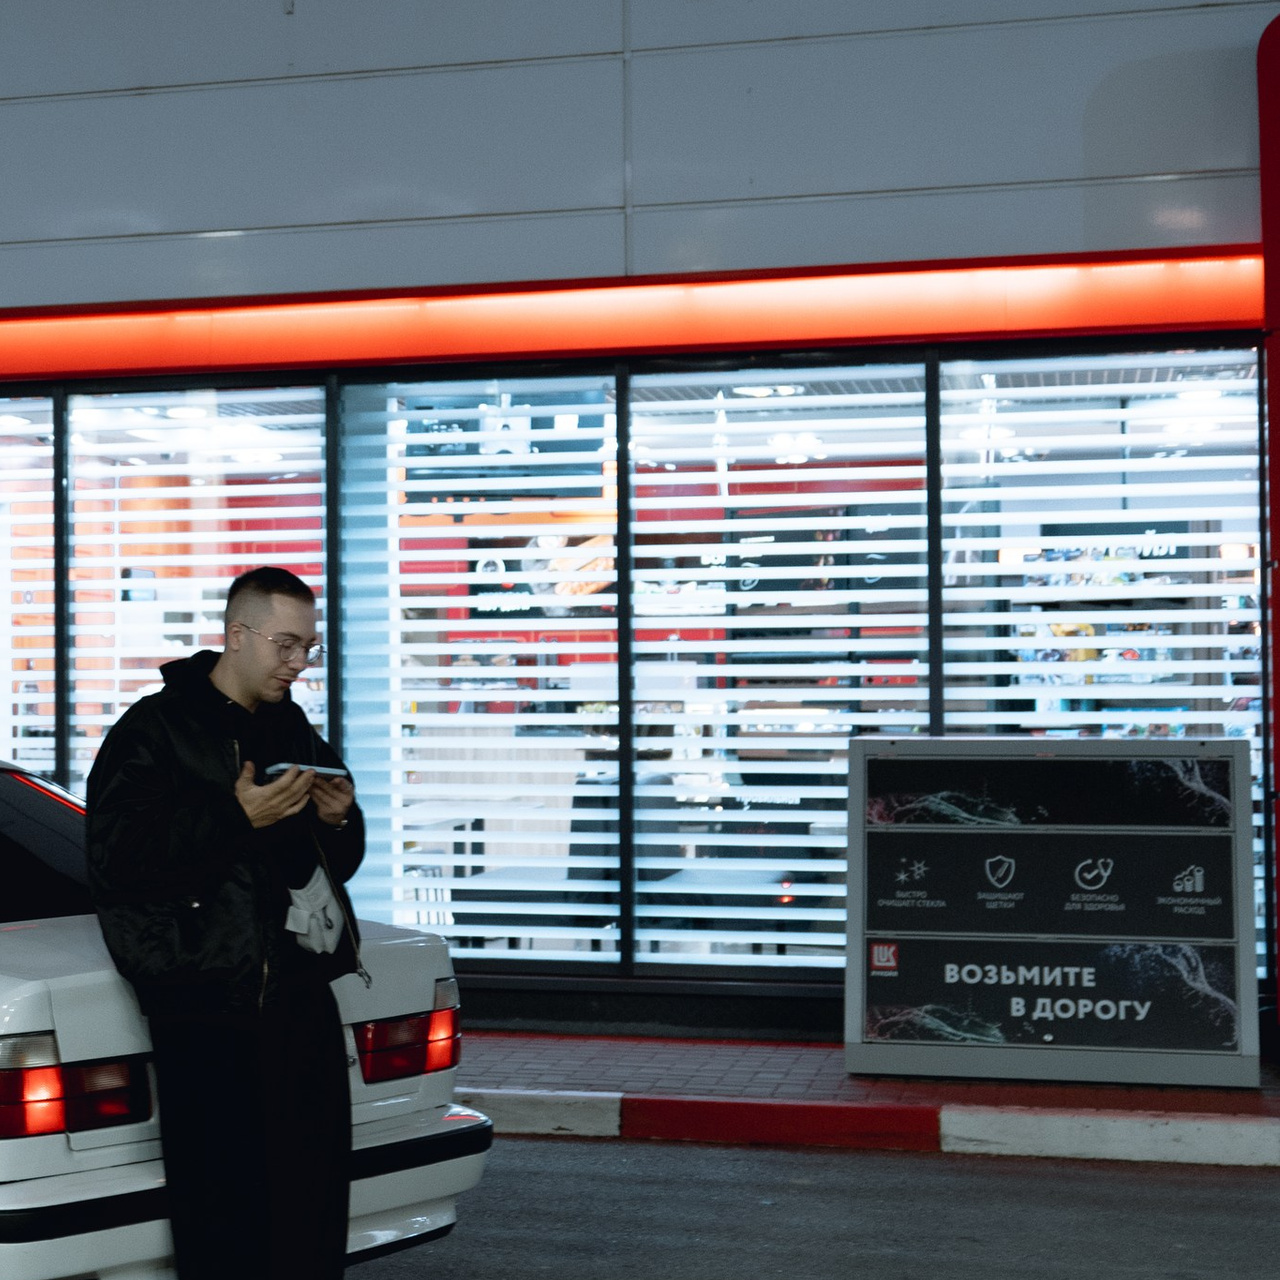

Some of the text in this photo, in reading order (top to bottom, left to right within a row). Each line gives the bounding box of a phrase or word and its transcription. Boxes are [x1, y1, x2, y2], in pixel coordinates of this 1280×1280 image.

[943, 963, 1097, 988] ВОЗЬМИТЕ
[1009, 997, 1152, 1022] В ДОРОГУ
